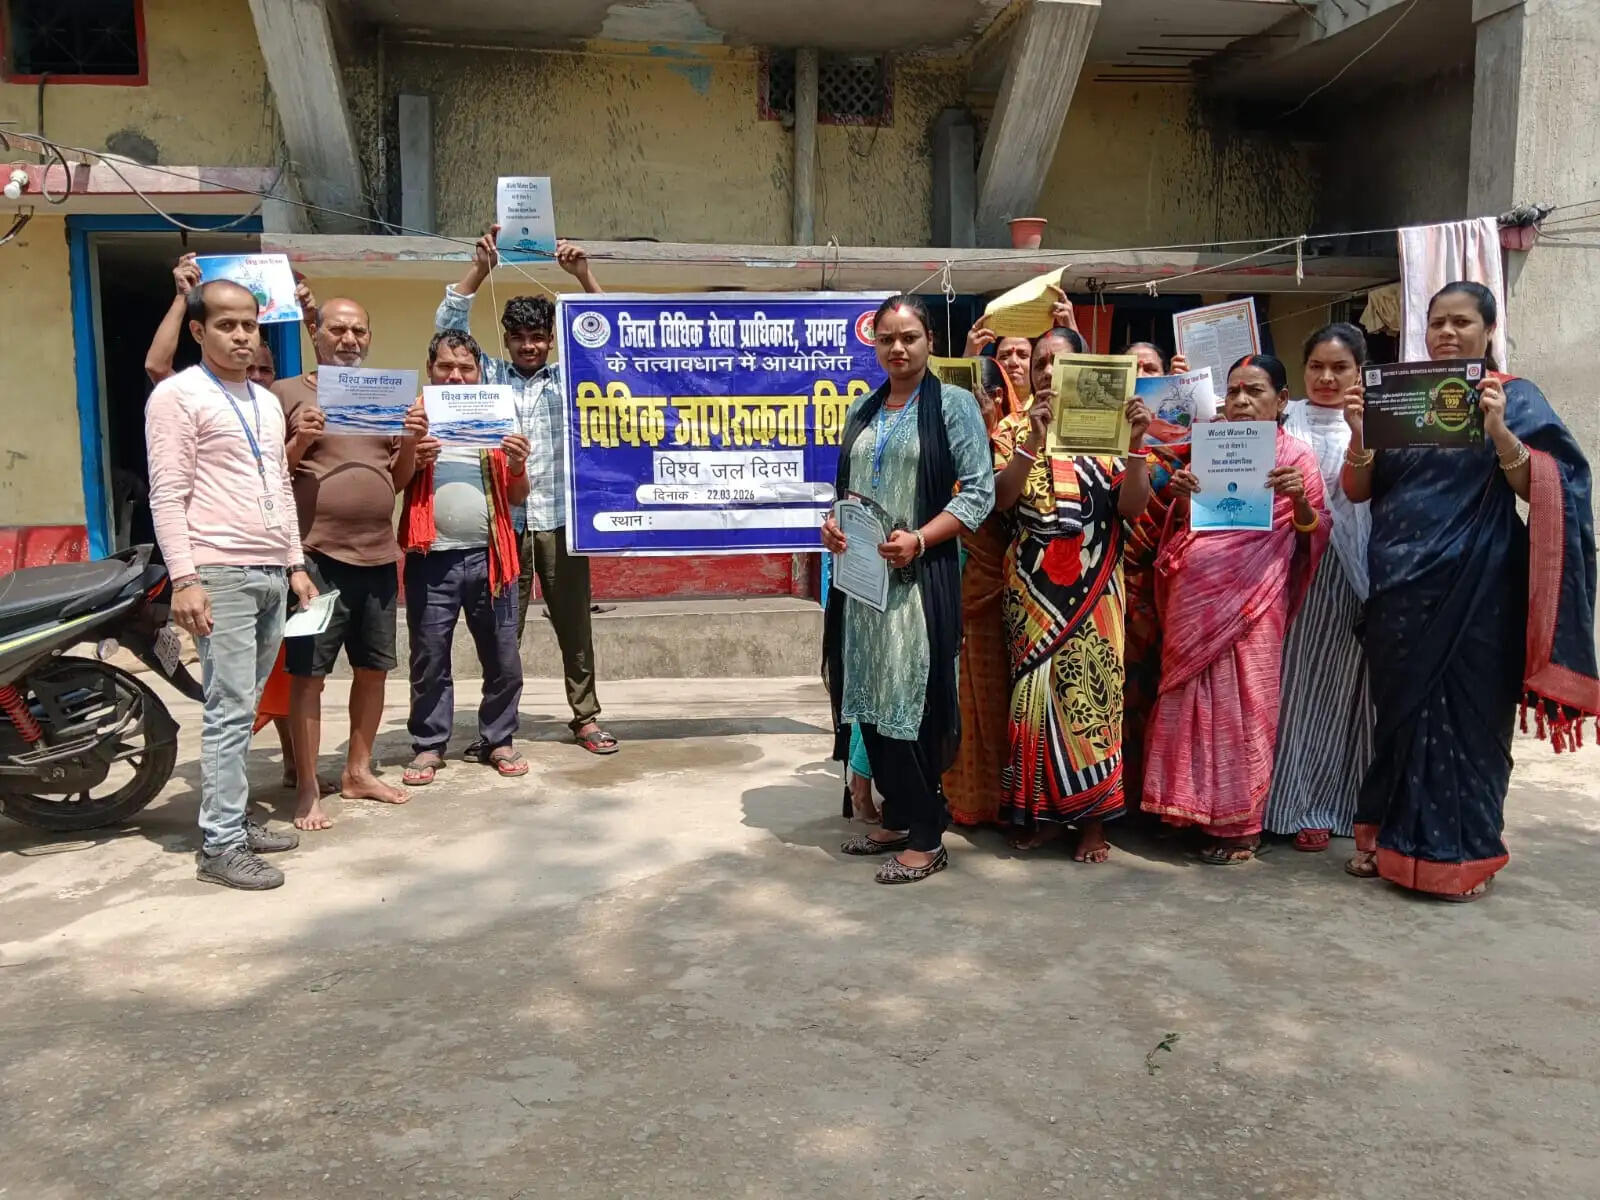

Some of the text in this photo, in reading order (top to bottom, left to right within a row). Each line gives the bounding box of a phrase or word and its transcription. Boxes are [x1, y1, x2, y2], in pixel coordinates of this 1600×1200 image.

[618, 311, 656, 348] जिला
[659, 311, 704, 348] विधिक
[707, 311, 736, 348] सेवा
[739, 311, 799, 353] प्राधिकार,
[605, 350, 854, 373] के तत्वावधान में आयोजित
[576, 381, 668, 448] विधिक
[1208, 427, 1258, 437] World Water Day
[658, 456, 800, 480] विश्व जल दिवस
[707, 488, 755, 500] 22.03.2026
[609, 515, 644, 527] स्थान
